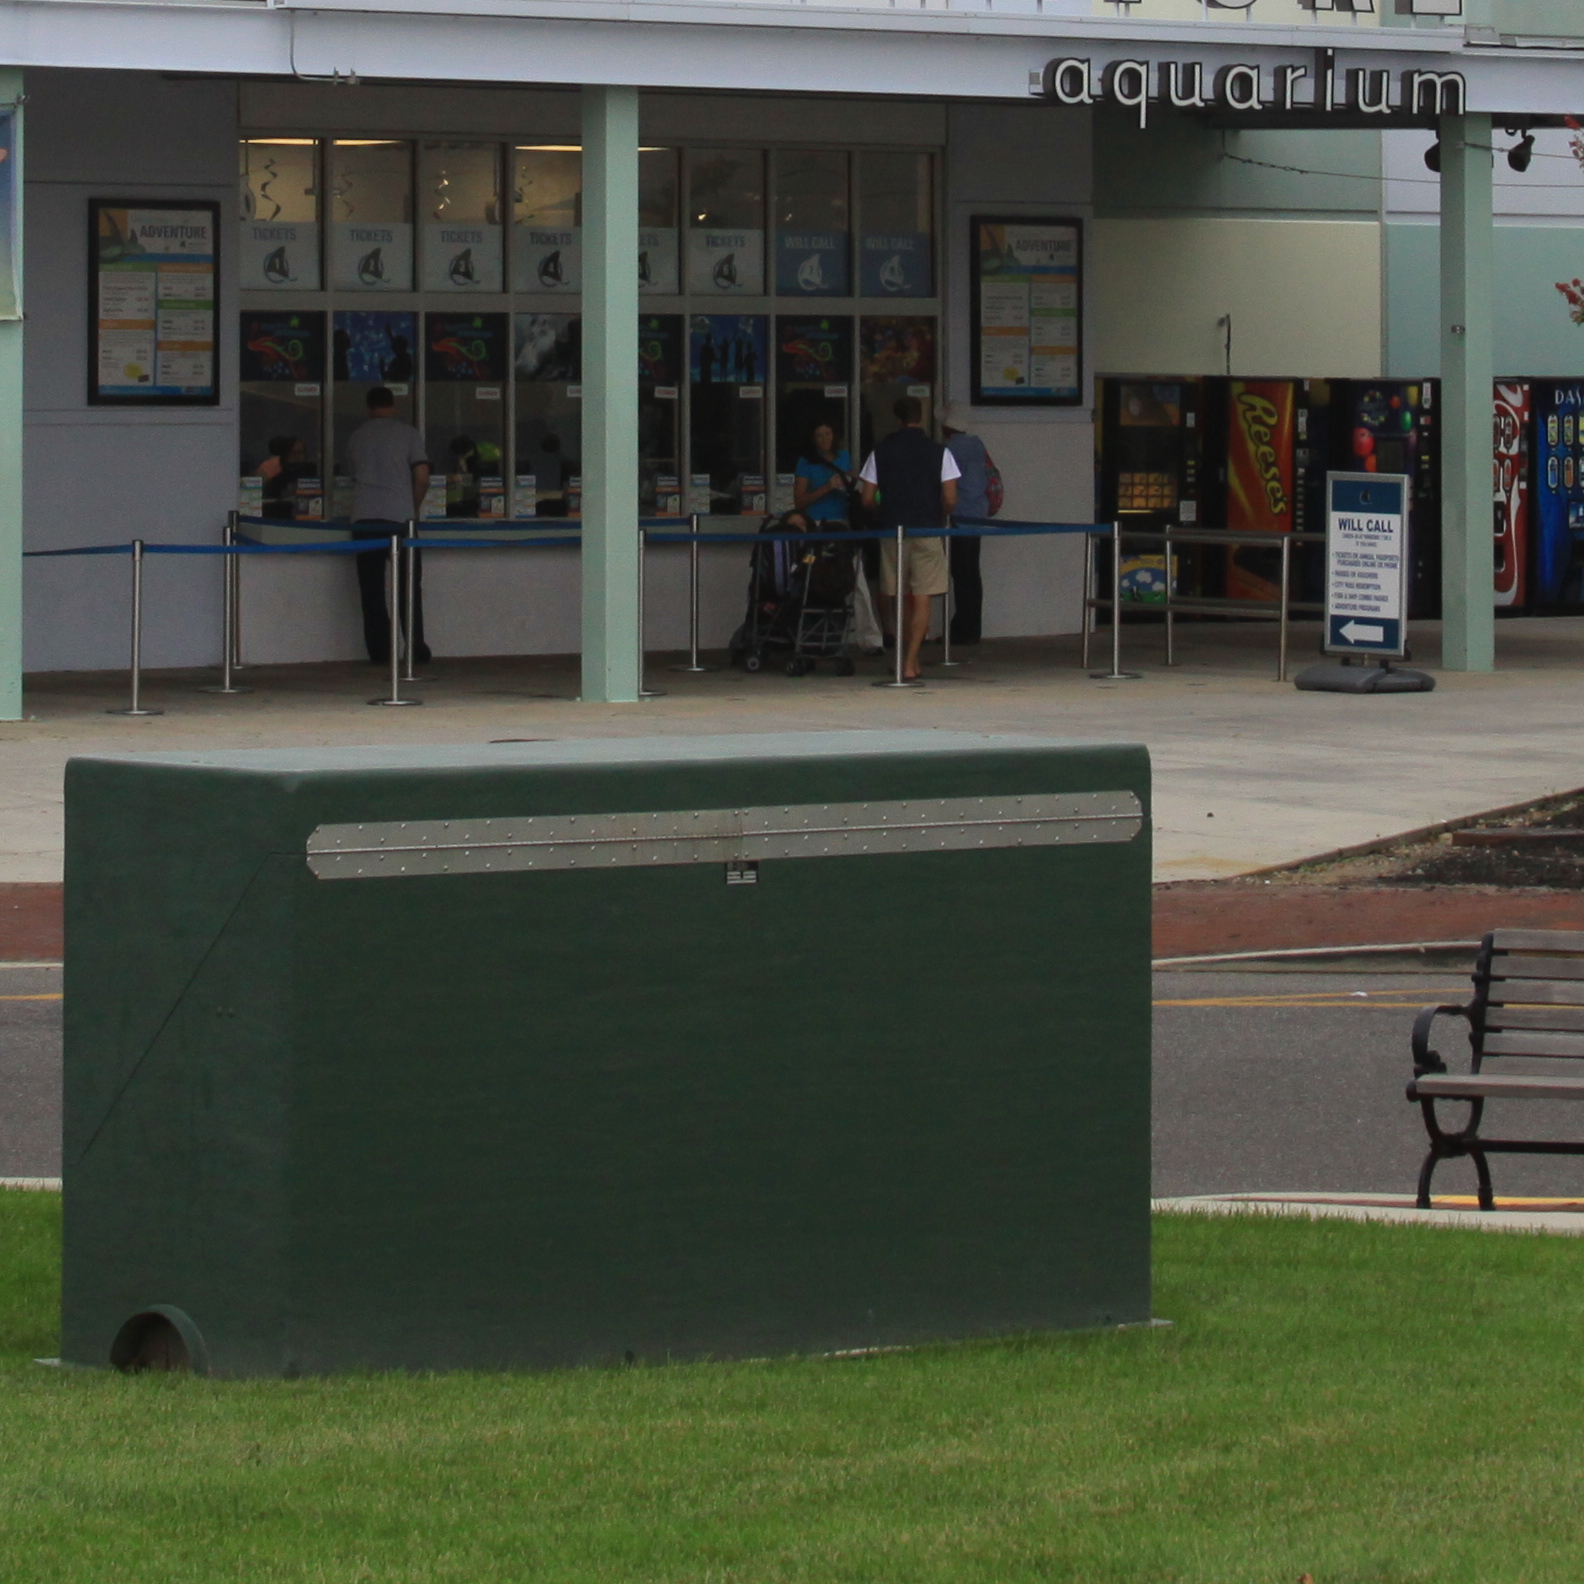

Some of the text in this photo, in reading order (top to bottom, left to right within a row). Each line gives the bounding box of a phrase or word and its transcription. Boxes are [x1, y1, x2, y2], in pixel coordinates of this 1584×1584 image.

[1044, 48, 1466, 129] aquarium
[140, 224, 208, 240] ADVENTURE
[253, 227, 297, 241] TICKETS
[349, 229, 394, 243] TICKETS
[441, 230, 483, 244] TICKETS
[530, 232, 573, 245] TICKETS
[705, 234, 746, 248] TICKETS
[1015, 239, 1073, 253] ADVENTURE
[1238, 393, 1288, 516] Reese's
[1338, 517, 1393, 533] WILL CALL
